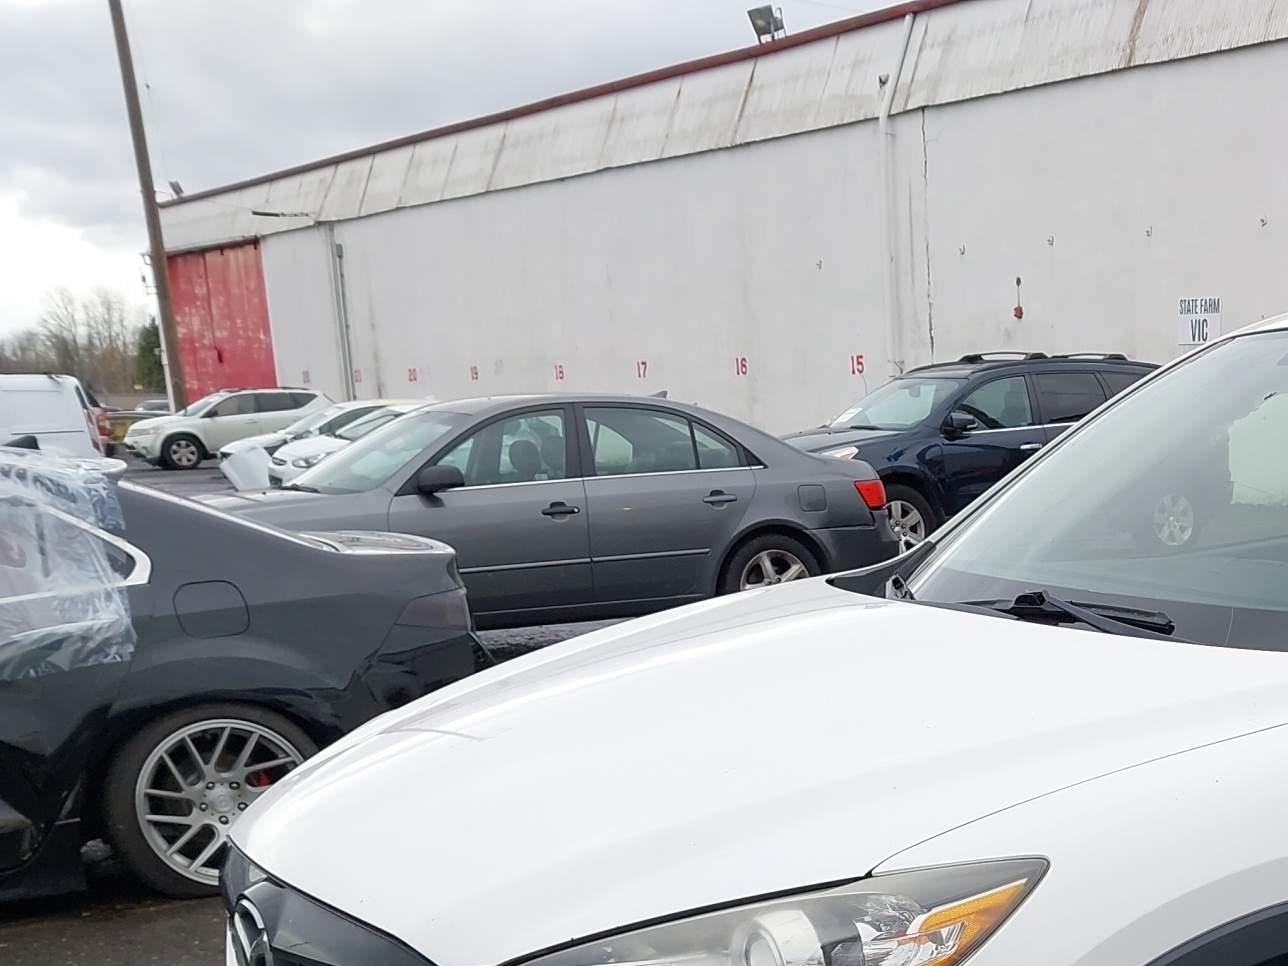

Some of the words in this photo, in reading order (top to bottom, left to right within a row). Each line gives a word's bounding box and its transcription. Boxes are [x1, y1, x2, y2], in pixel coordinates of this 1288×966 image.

[1179, 298, 1198, 315] STATE
[1200, 297, 1220, 314] FARM
[1190, 318, 1208, 342] VIC
[637, 360, 647, 379] 17
[735, 356, 747, 375] 16
[850, 354, 864, 375] 15
